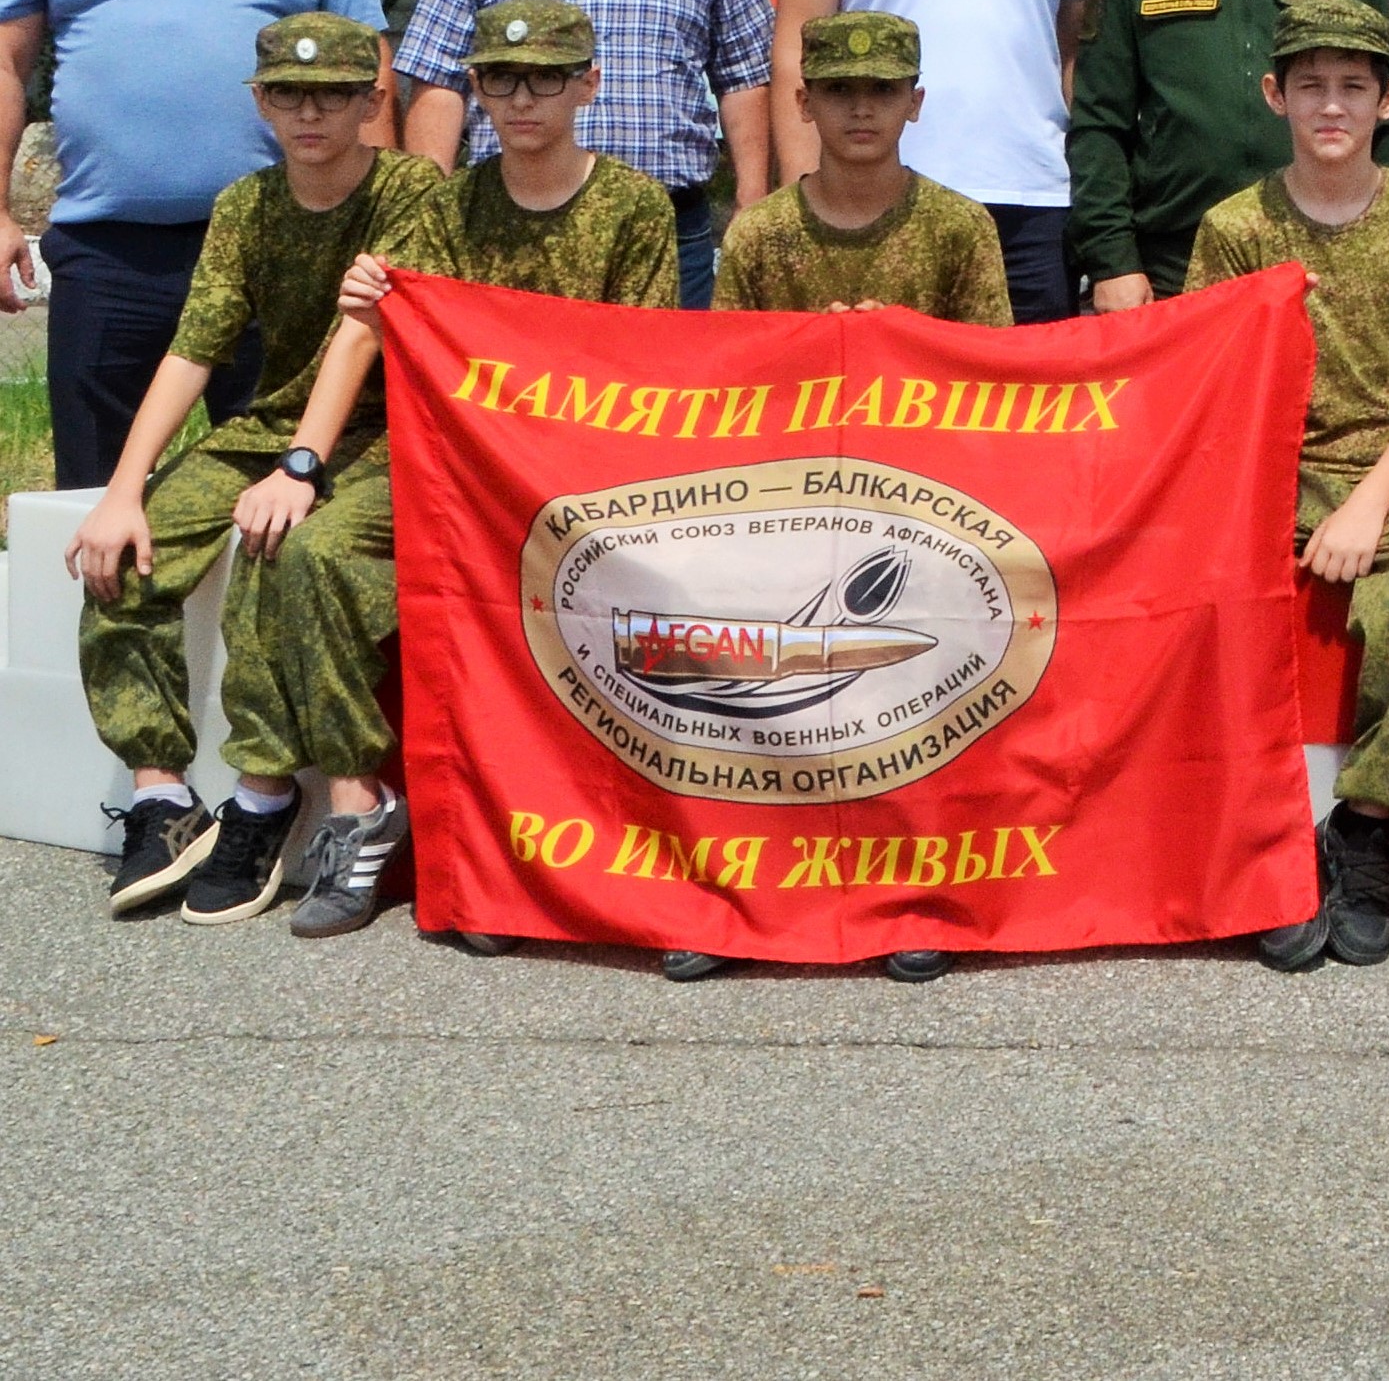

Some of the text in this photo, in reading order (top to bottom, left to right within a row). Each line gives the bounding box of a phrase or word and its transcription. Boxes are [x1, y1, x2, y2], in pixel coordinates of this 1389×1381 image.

[450, 356, 1132, 440] ПАМЯТИ ПАВШИХ
[546, 478, 750, 542] КАБАРДИНО
[802, 471, 1017, 552] БАЛКАРСКАЯ
[560, 516, 1003, 622] РОССИЙСКИЙ СОЮЗ ВЕТЕРАНОВ АФГАНИСТАНА
[557, 665, 1018, 793] РЕГИОНАЛЬНАЯ ОРГАНИЗАЦИЯ
[575, 642, 988, 747] И СПЕЦИАЛЬНЫХ ВОЕННЫХ ОПЕРАЦИЙ
[507, 810, 1068, 893] ВО ИМЯ ЖИВЫХ
